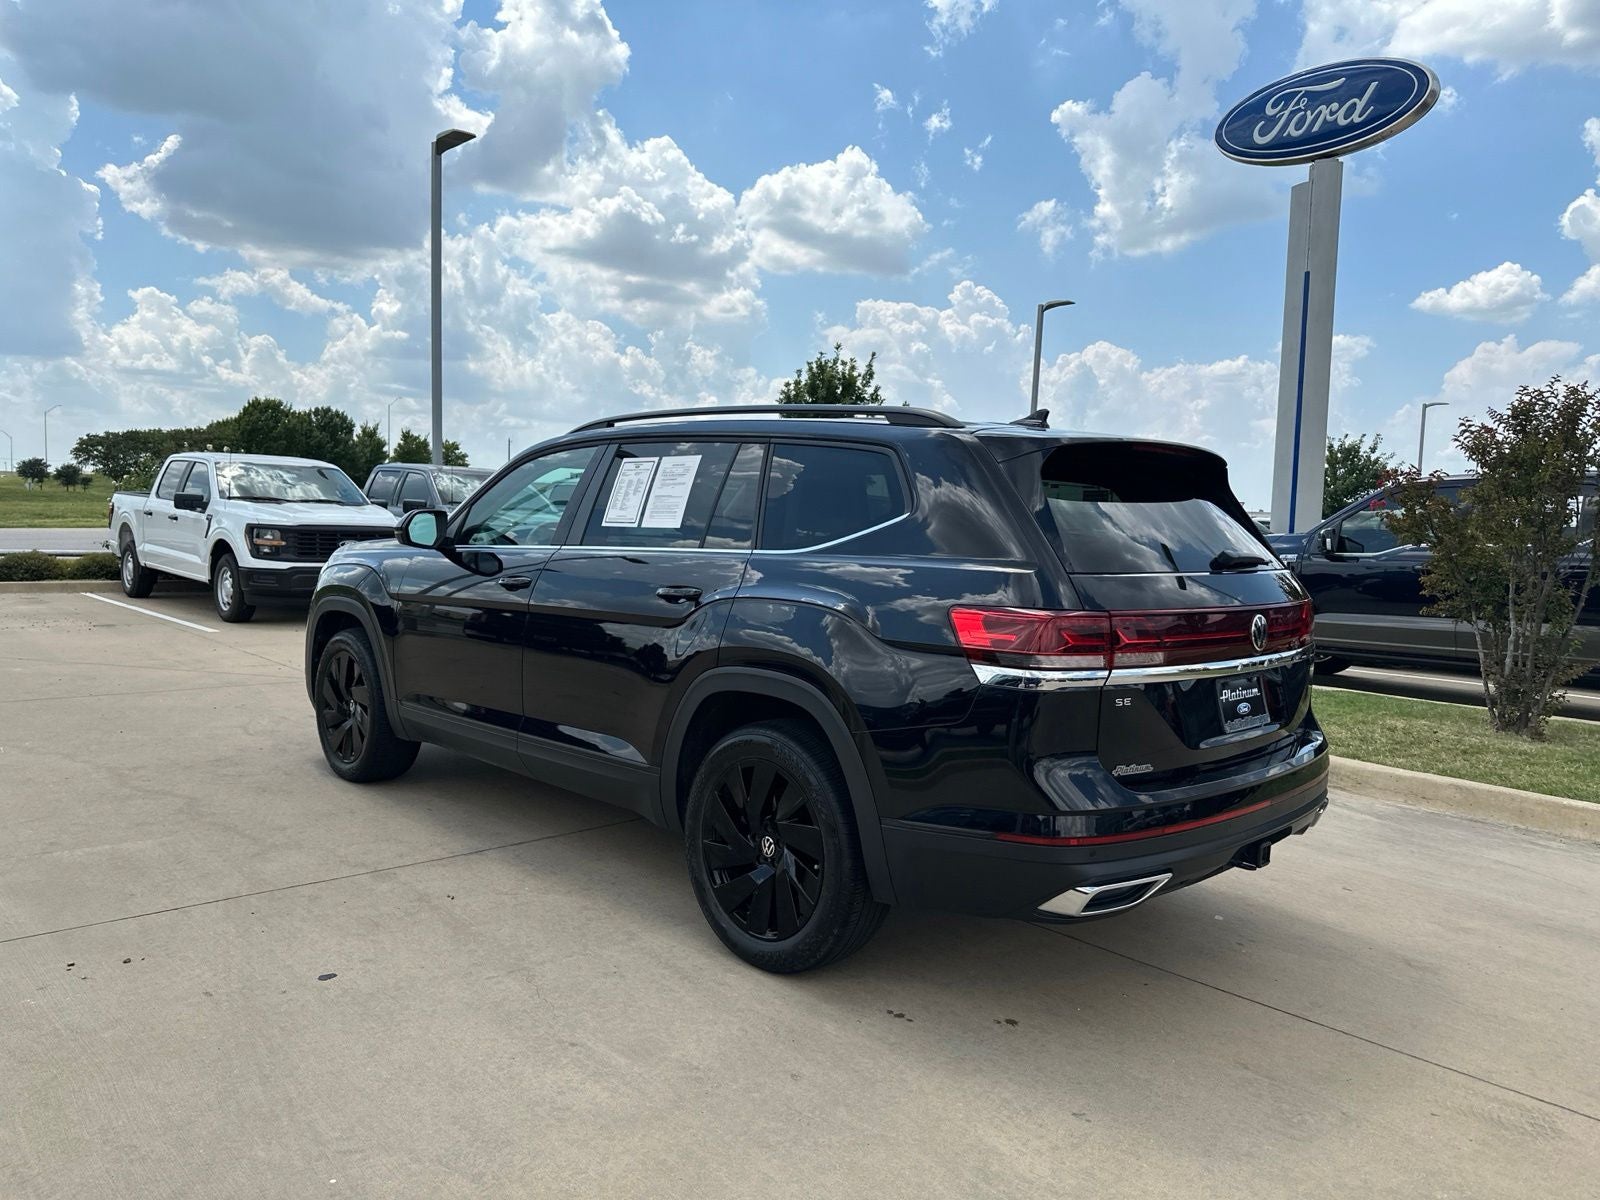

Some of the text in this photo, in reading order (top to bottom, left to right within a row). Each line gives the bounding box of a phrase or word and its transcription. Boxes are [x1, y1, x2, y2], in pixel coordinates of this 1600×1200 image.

[1253, 78, 1379, 145] Ford
[1220, 687, 1261, 702] Platinum
[1115, 697, 1132, 707] SE
[1112, 764, 1154, 776] Platinum
